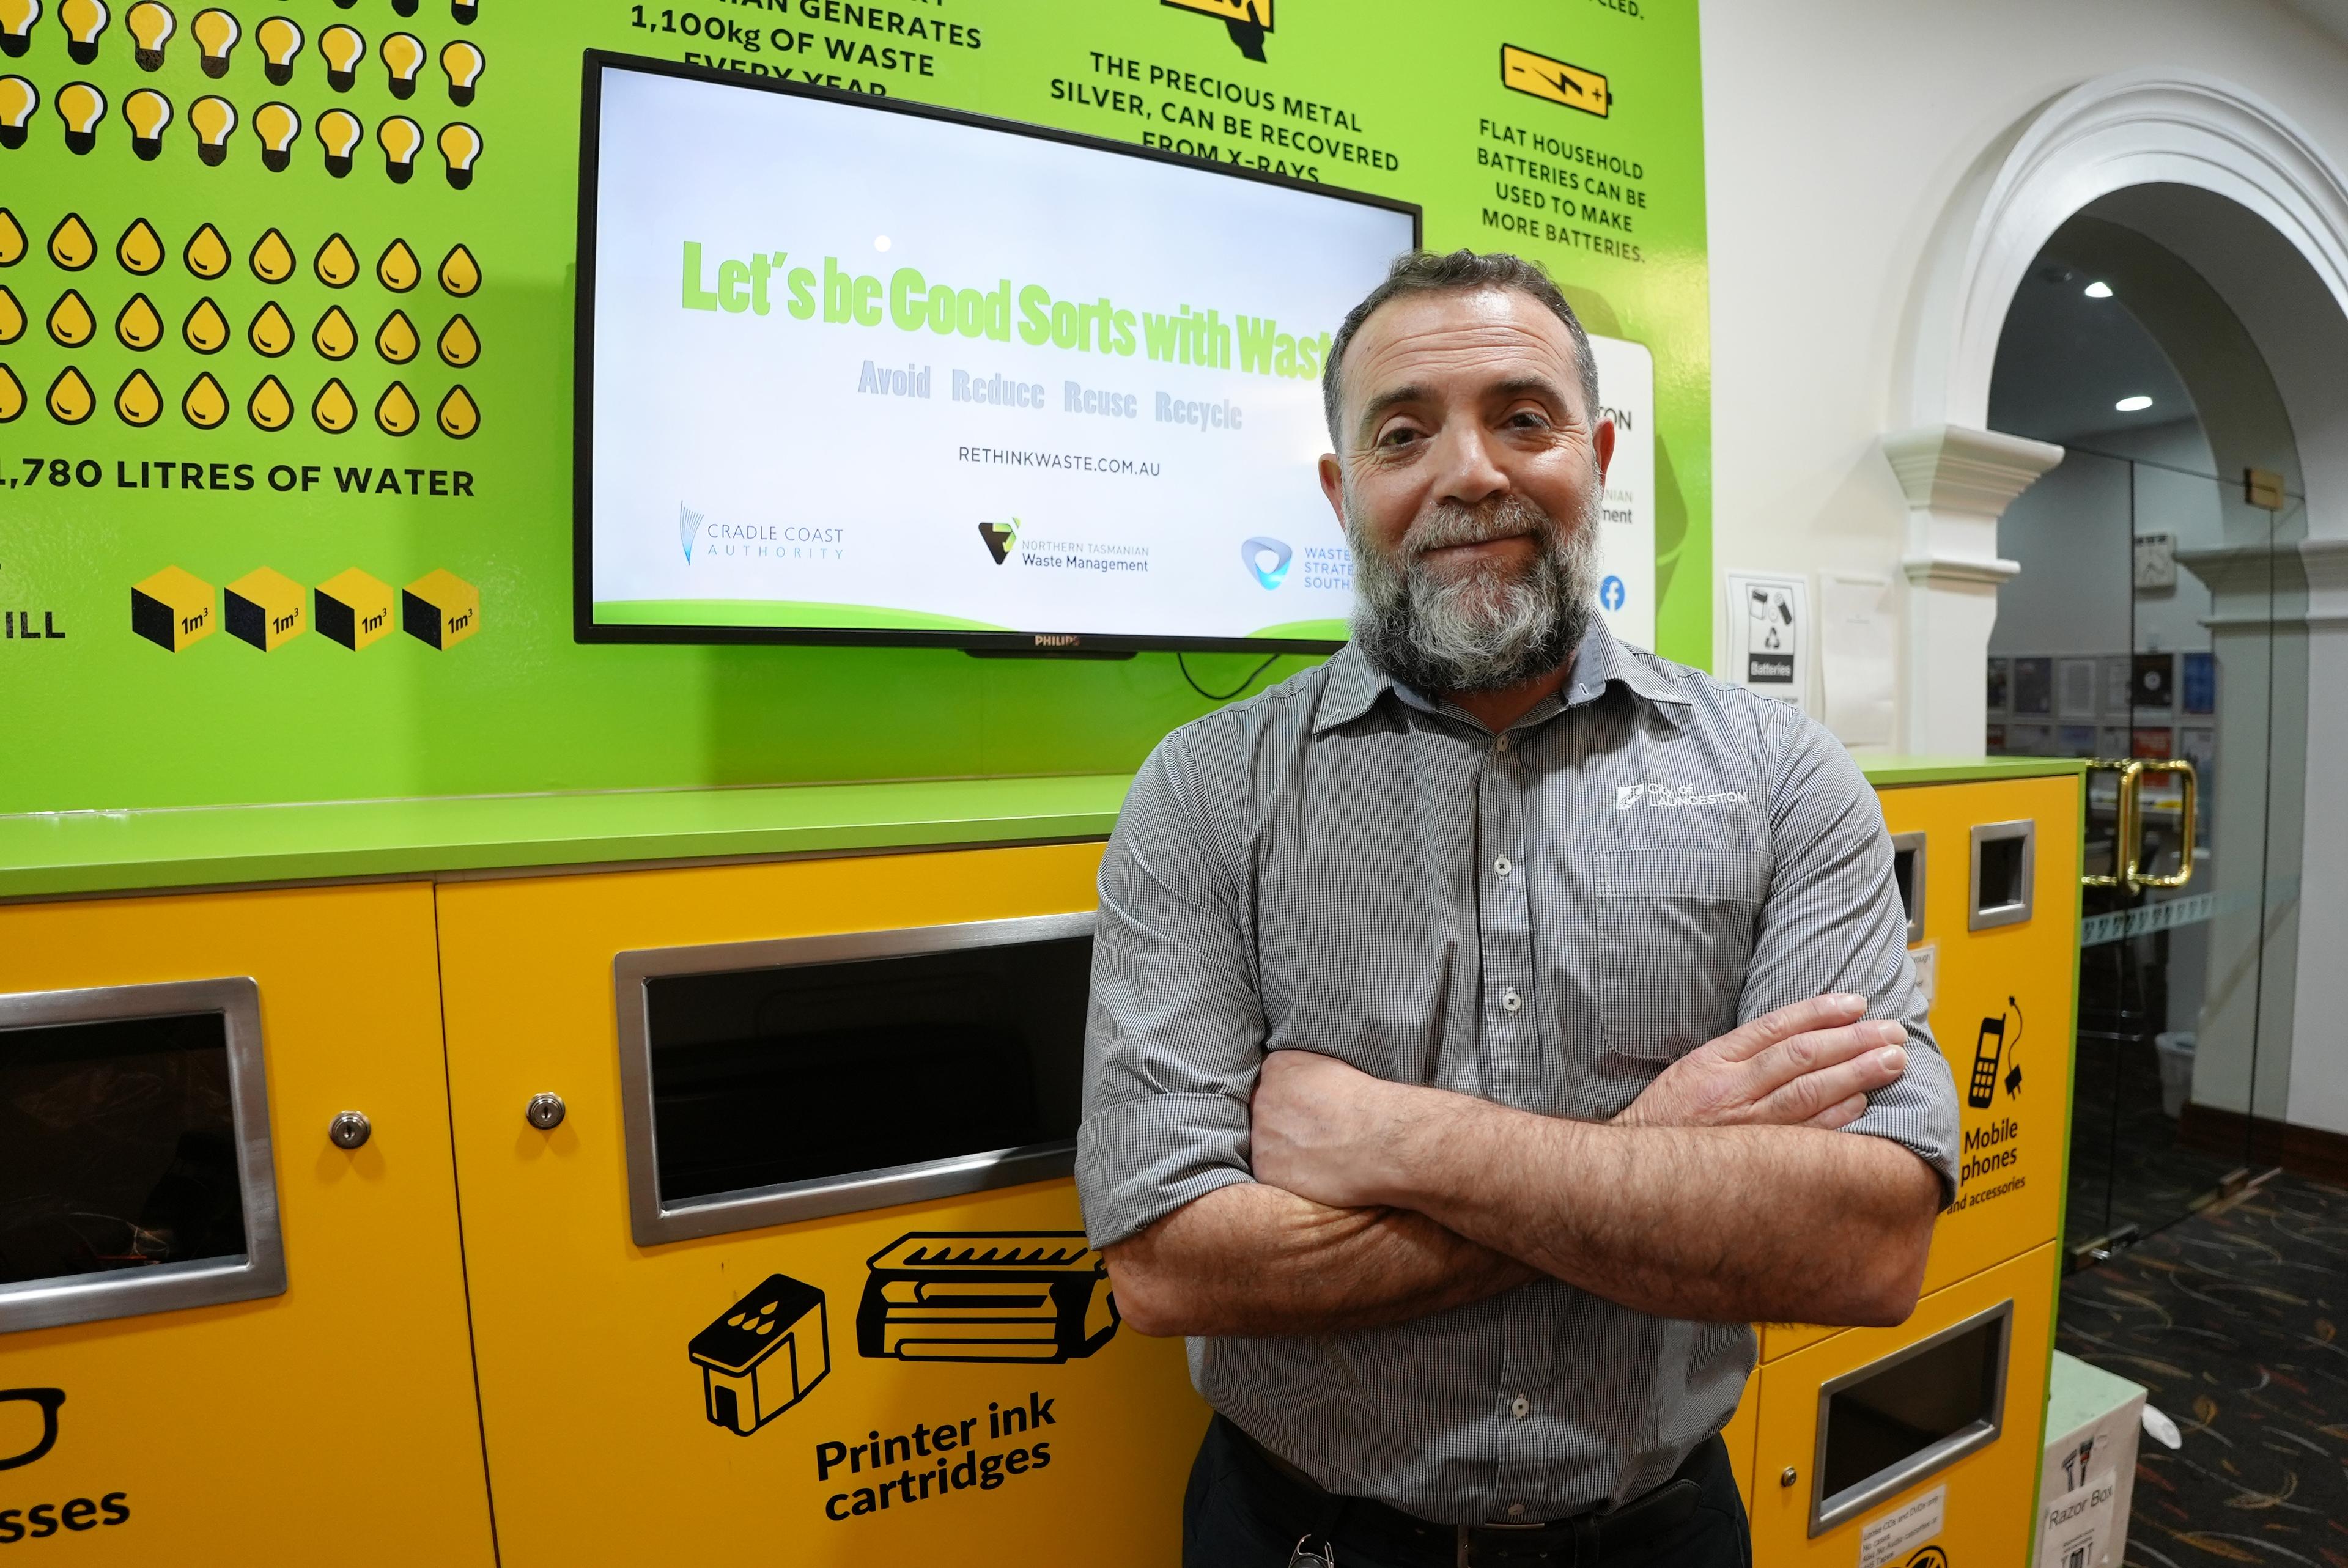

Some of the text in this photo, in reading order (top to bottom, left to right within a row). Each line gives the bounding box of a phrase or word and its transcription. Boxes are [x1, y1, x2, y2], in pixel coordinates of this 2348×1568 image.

[632, 5, 934, 77] 1,100kg OF WASTE
[800, 0, 981, 50] GENERATES
[1090, 51, 1362, 133] THE PRECIOUS METAL
[1050, 78, 1398, 171] SILVER, CAN BE RECOVERED
[1143, 131, 1320, 183] FROM X-RAYS
[1480, 119, 1643, 179] FLAT HOUSEHOLD
[1477, 147, 1647, 209] BATTERIES CAN BE
[1496, 181, 1633, 233] USED TO MAKE
[1482, 208, 1645, 263] MORE BATTERIES.
[682, 241, 1333, 381] Let's be Good Sorts with Wast
[858, 359, 1243, 433] Avoid Reduce Reuse Recycle
[117, 461, 254, 491] LITRES
[268, 465, 321, 492] OF
[334, 466, 475, 496] WATER
[959, 446, 1161, 477] RETHINKWASTE.COM.AU
[707, 523, 844, 543] CRADLE COAST
[708, 544, 844, 559] AUTHORITY
[1022, 540, 1150, 557] NORTHERN TASMANIAN
[1022, 553, 1148, 573] Waste Management
[1305, 547, 1351, 561] WASTE
[1305, 562, 1354, 576] STRATE
[1035, 635, 1081, 646] PHILIPS
[1751, 661, 1792, 677] Batteries
[1648, 783, 1694, 797] City of
[1650, 792, 1748, 807] LAUNCESTON
[1964, 1117, 2018, 1154] Mobile
[1960, 1147, 2017, 1187] phones
[1969, 1176, 2026, 1207] accessories
[816, 1391, 1057, 1481] Printer ink
[825, 1441, 1051, 1522] cartridges
[2048, 1485, 2113, 1529] Razor Box
